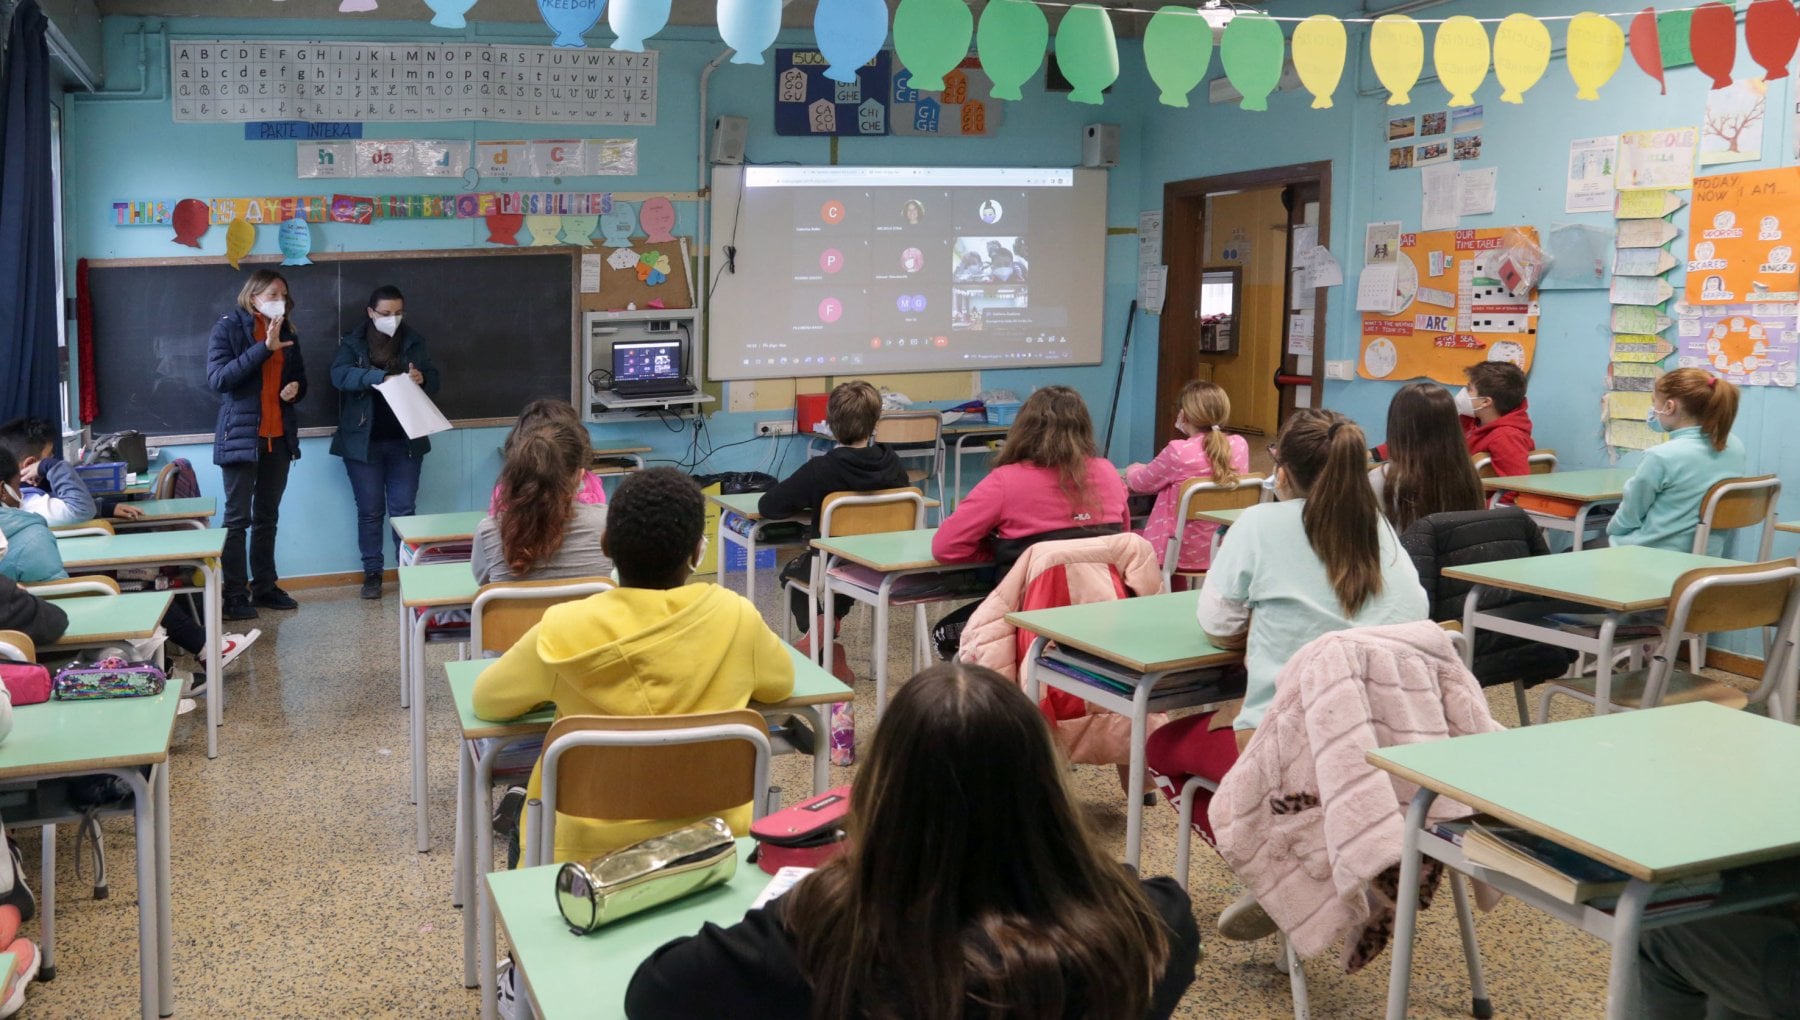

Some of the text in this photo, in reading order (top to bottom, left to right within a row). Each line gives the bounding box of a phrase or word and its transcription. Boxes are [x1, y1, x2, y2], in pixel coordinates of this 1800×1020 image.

[181, 50, 189, 59] A
[201, 49, 208, 59] B
[221, 49, 228, 59] C
[240, 49, 248, 58] D
[260, 49, 266, 58] E
[280, 50, 286, 59] F
[298, 50, 306, 60] G
[317, 50, 325, 60] H
[356, 51, 360, 61] J
[371, 51, 378, 60] K
[391, 52, 396, 61] L
[407, 52, 418, 61] M
[427, 52, 435, 61] N
[445, 52, 454, 61] O
[465, 52, 472, 60] P
[482, 52, 491, 62] Q
[501, 53, 507, 62] R
[519, 53, 525, 63] S
[537, 54, 544, 63] T
[554, 55, 562, 64] U
[572, 55, 580, 64] V
[588, 56, 599, 64] W
[608, 56, 615, 65] X
[626, 57, 632, 66] Y
[643, 58, 649, 67] Z
[182, 70, 189, 78] a
[202, 67, 208, 78] b
[240, 65, 247, 77] d
[260, 69, 266, 77] e
[281, 66, 286, 76] f
[298, 71, 304, 80] g
[317, 67, 324, 78] h
[355, 69, 360, 80] j
[371, 68, 377, 78] k
[465, 71, 472, 80] p
[483, 71, 489, 80] q
[537, 72, 542, 81] t
[625, 76, 631, 86] y
[785, 71, 803, 81] GA
[784, 80, 803, 90] GO
[783, 91, 803, 101] GU
[837, 91, 860, 101] GHE
[895, 90, 917, 101] CE
[815, 105, 832, 115] CA
[859, 107, 878, 118] CHI
[918, 106, 935, 119] GI
[815, 114, 833, 123] CO
[260, 122, 350, 138] PARTE INTERA
[815, 122, 834, 131] CU
[861, 121, 881, 131] CHE
[916, 119, 937, 132] GE
[493, 149, 508, 165] d
[1697, 176, 1738, 189] TODAY
[1697, 190, 1728, 201] NOW
[113, 200, 171, 225] THIS
[245, 200, 263, 223] A
[265, 198, 324, 222] YEAR
[457, 194, 497, 218] OF
[503, 193, 613, 215] POSSIBILITIES
[828, 206, 838, 218] C
[1456, 230, 1474, 239] OUR
[1760, 231, 1780, 239] SAD
[827, 255, 836, 266] P
[1688, 260, 1727, 271] SCARED
[1761, 263, 1796, 272] ANGRY
[1703, 291, 1734, 299] HAPPY
[901, 299, 909, 308] M
[914, 298, 922, 308] G
[826, 304, 834, 316] F
